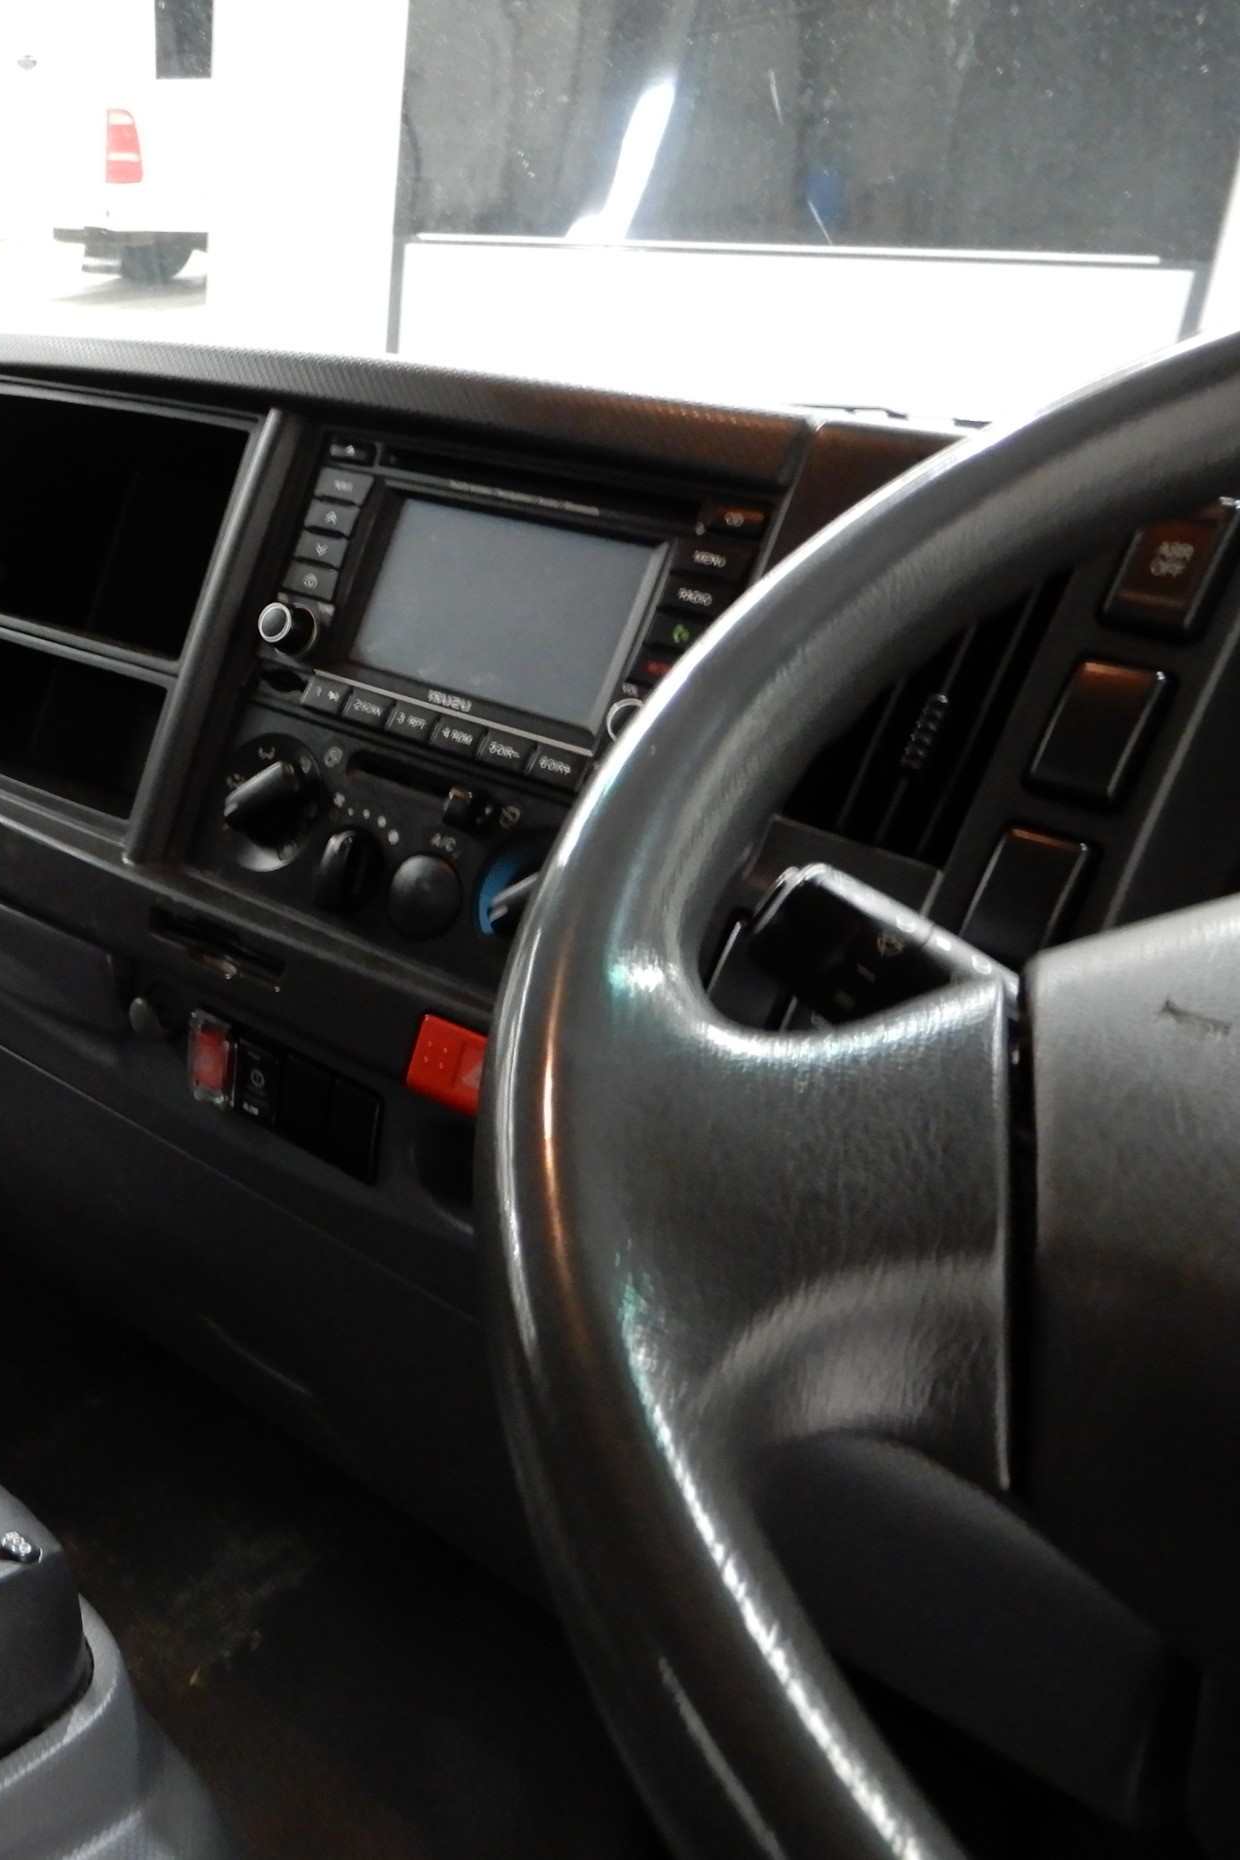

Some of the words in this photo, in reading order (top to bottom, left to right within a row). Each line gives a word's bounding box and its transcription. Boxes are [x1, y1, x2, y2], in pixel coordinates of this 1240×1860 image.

[693, 550, 726, 568] MENU
[678, 587, 712, 606] RADIO
[427, 689, 472, 712] ISUZU
